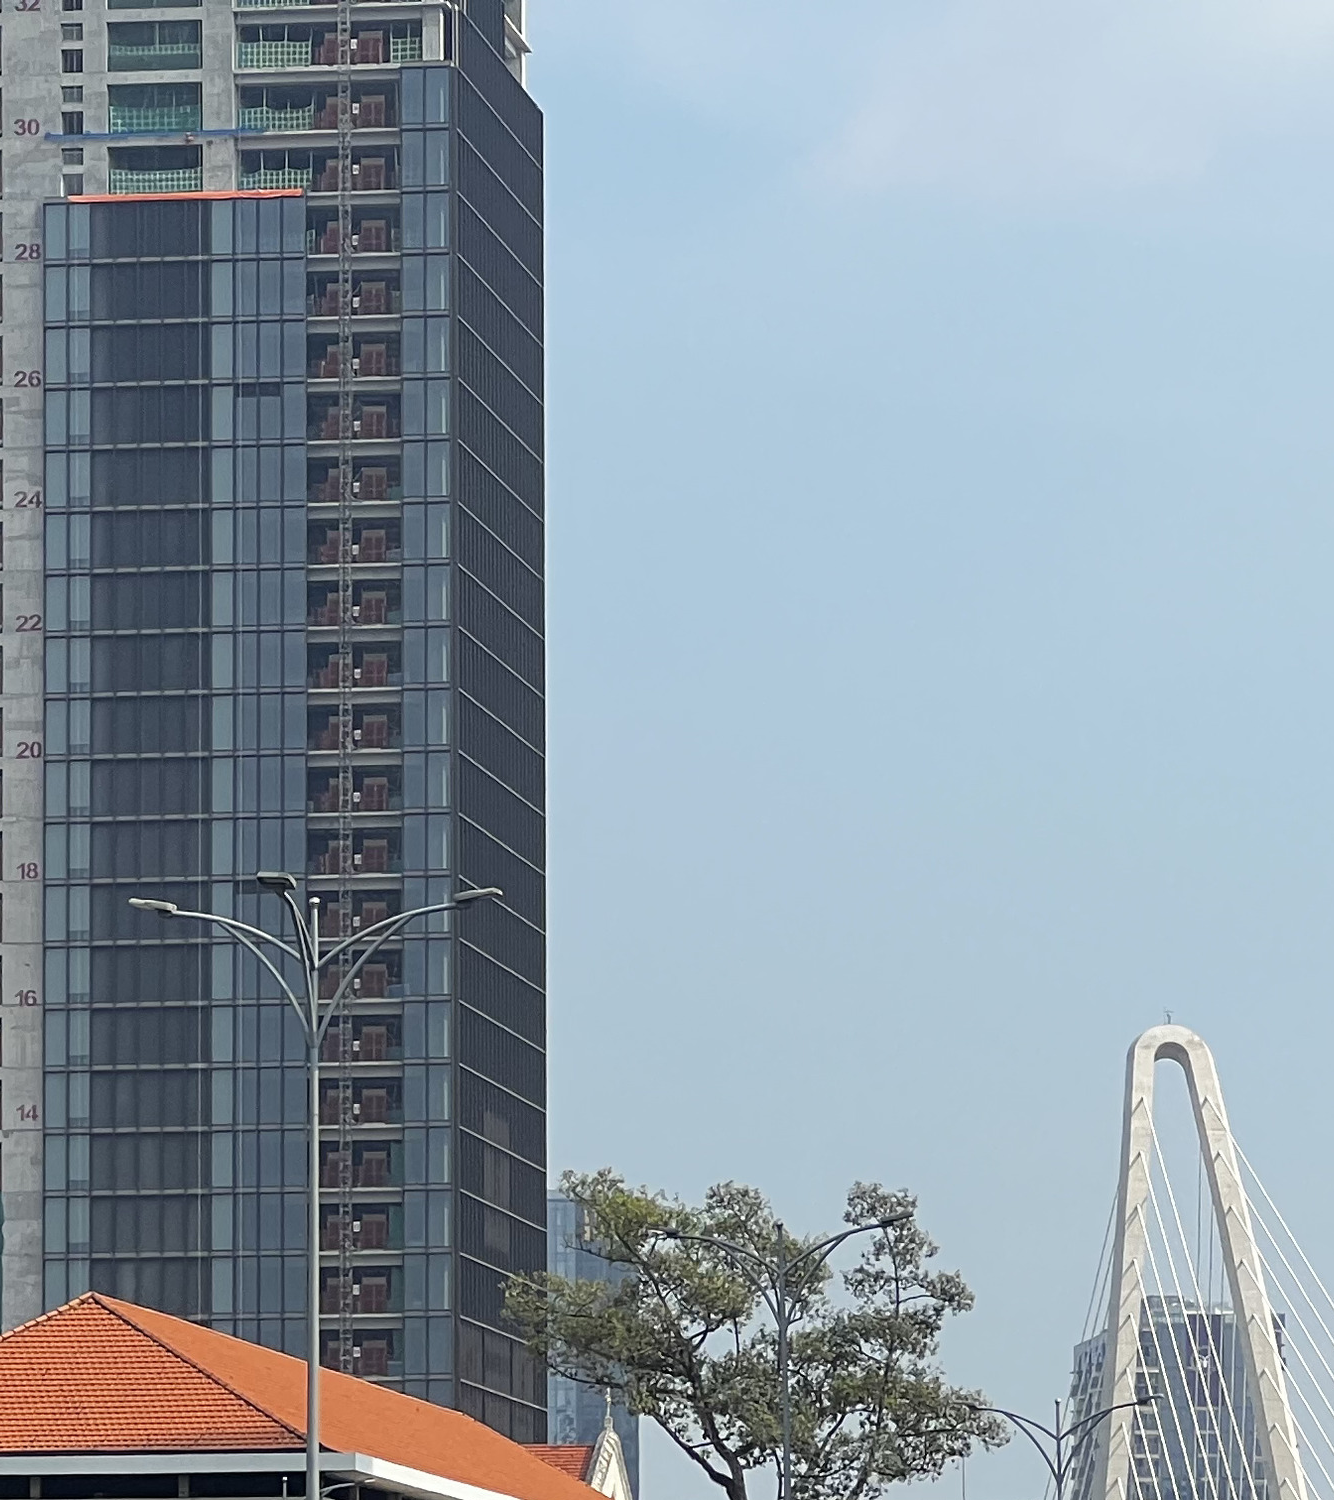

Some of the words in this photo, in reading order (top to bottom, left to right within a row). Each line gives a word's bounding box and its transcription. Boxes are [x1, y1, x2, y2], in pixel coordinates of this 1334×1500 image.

[14, 118, 40, 136] 30
[15, 243, 41, 260] 28
[14, 370, 41, 387] 26
[14, 490, 42, 508] 24
[16, 614, 42, 632] 22
[16, 741, 42, 759] 20
[17, 862, 38, 880] 18
[15, 989, 37, 1007] 16
[16, 1104, 38, 1121] 14
